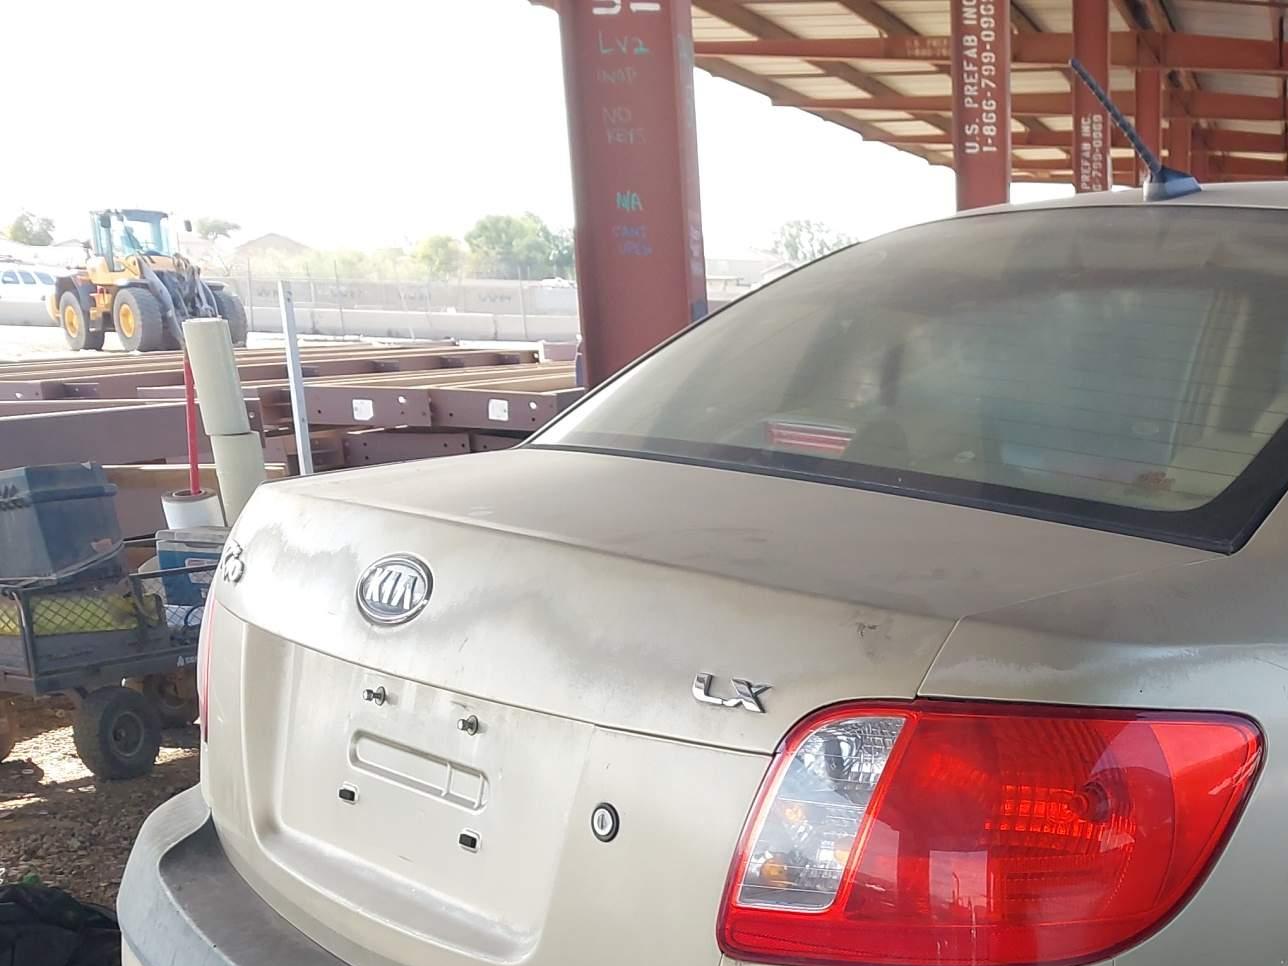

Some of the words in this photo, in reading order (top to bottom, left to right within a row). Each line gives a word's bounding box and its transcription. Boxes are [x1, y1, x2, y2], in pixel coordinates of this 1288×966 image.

[962, 34, 980, 109] PREFAB
[980, 0, 998, 152] 1-866-799-096
[964, 118, 980, 154] U.S.
[366, 566, 420, 611] KIA
[692, 671, 774, 714] LX
